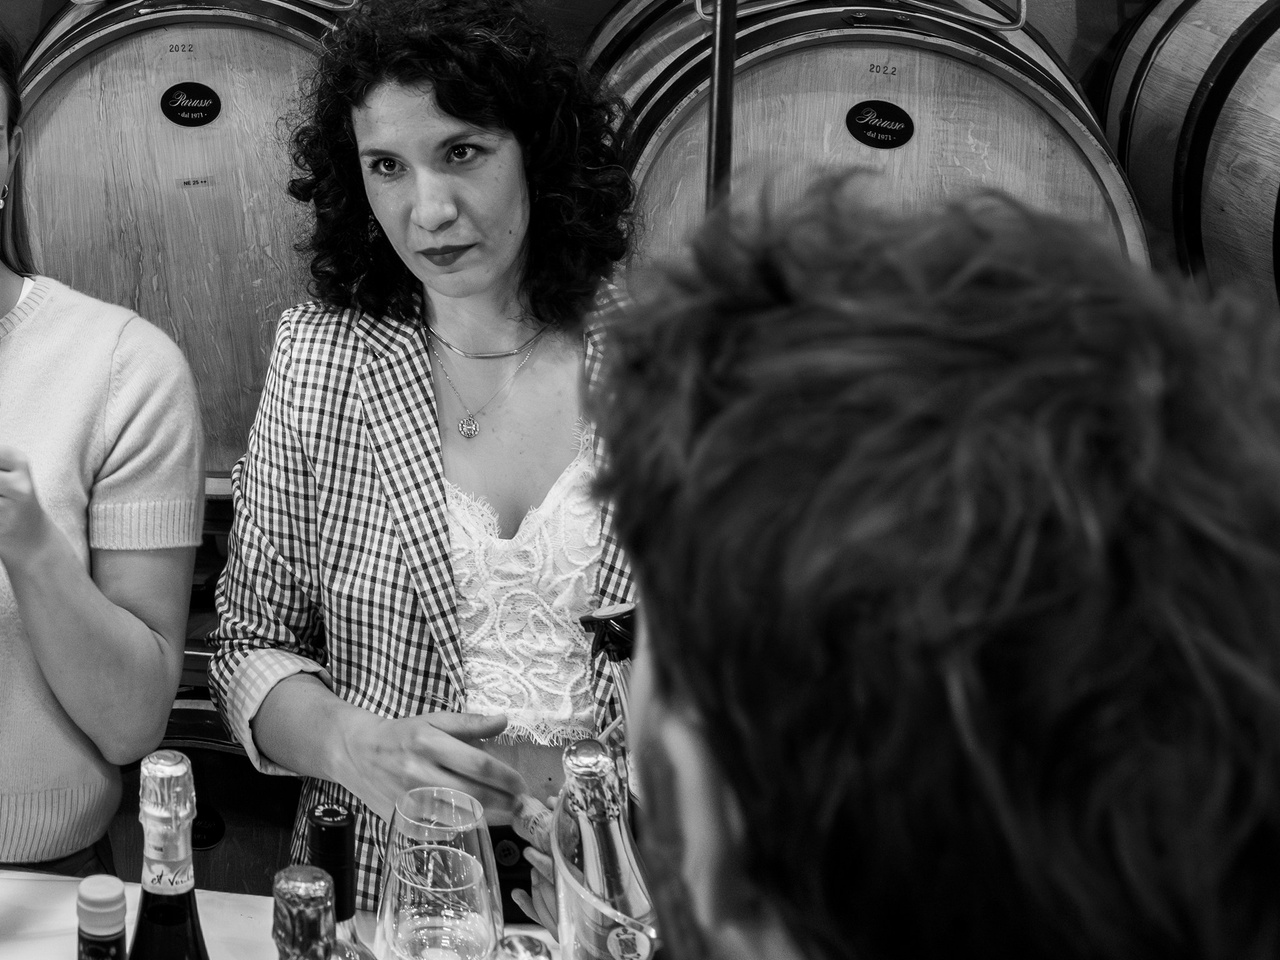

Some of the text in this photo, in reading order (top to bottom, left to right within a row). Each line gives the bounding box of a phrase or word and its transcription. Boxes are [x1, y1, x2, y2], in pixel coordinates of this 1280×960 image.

[169, 44, 194, 52] 2022
[869, 63, 897, 76] 2022
[169, 90, 212, 107] Parusso
[855, 107, 905, 130] Parusso
